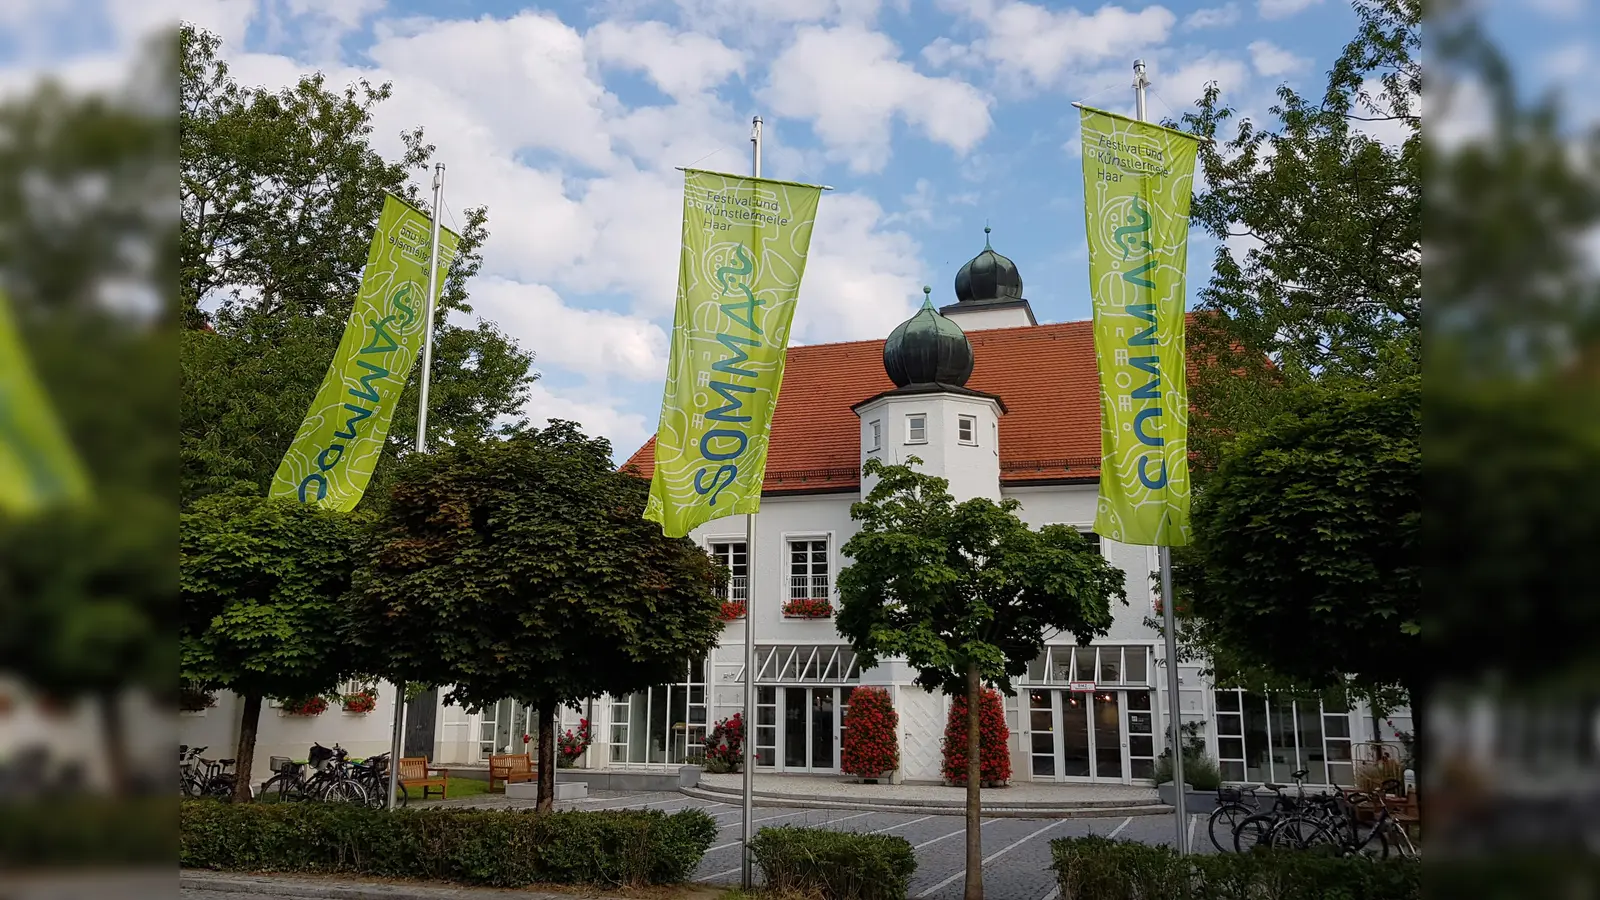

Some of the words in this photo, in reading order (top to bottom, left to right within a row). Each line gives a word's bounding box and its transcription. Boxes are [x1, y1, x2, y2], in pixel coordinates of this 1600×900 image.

[1099, 134, 1142, 155] Festival
[1145, 146, 1163, 161] und
[1097, 168, 1124, 182] Haar
[706, 190, 752, 207] Festival
[755, 200, 779, 211] und
[703, 218, 732, 231] Haar
[704, 204, 789, 227] Künstlermeile
